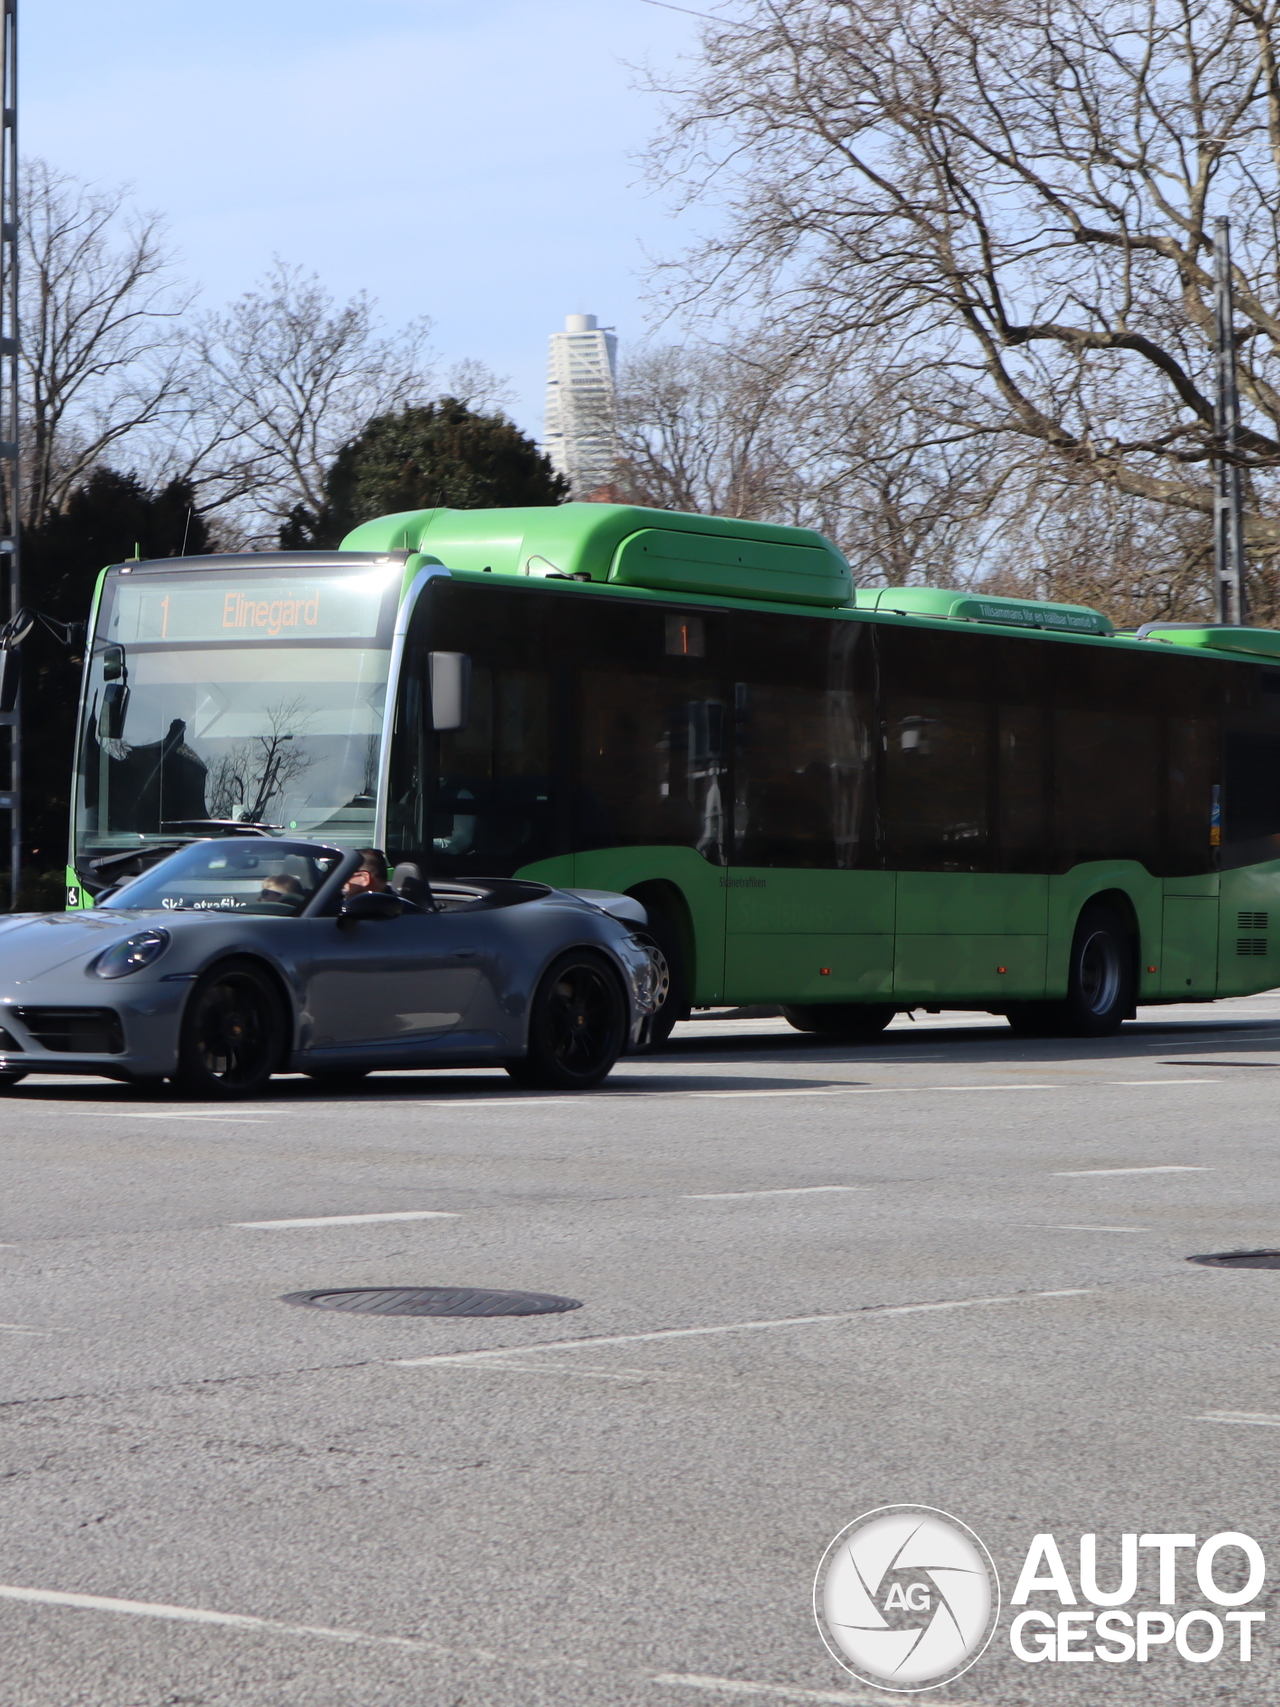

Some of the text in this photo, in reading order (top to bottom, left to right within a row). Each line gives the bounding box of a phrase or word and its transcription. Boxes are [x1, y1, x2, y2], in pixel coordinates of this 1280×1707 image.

[161, 590, 321, 639] 1 Elinegård
[978, 604, 1024, 620] Tillsammans
[1034, 614, 1044, 622] en
[681, 624, 688, 654] 1
